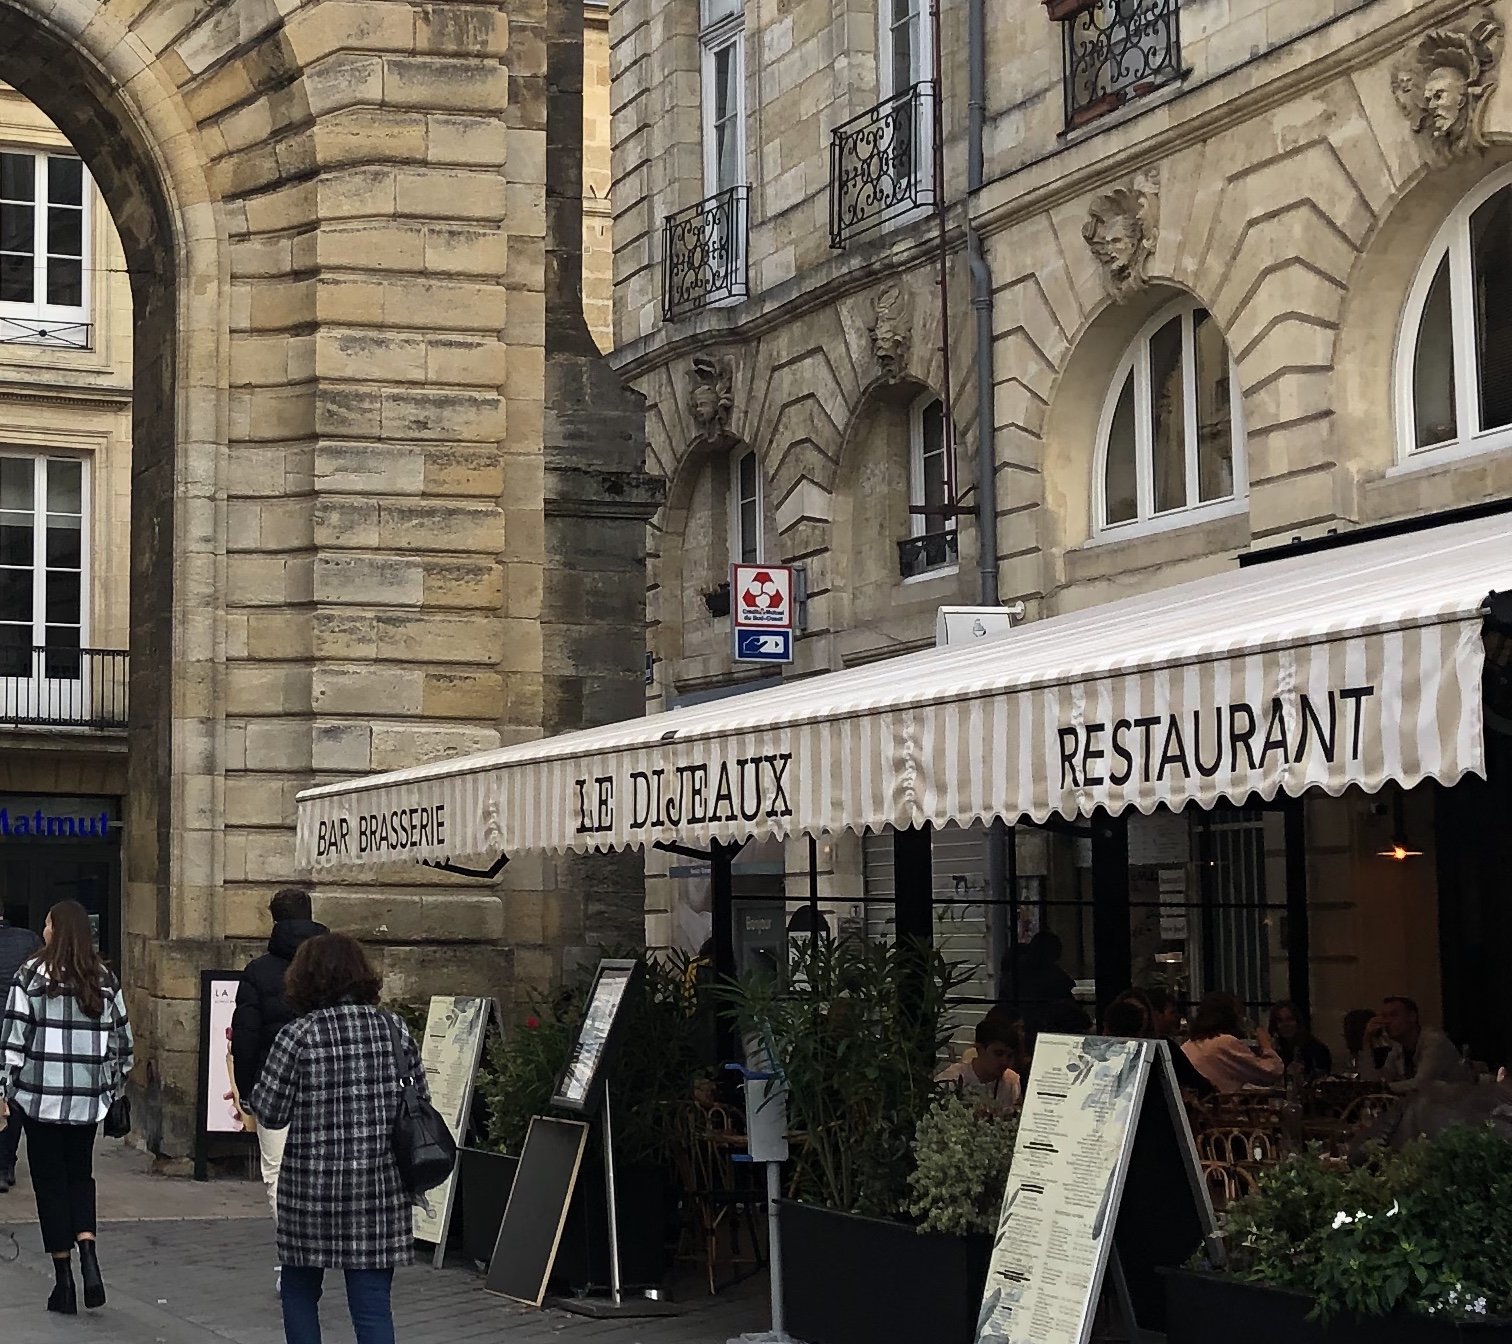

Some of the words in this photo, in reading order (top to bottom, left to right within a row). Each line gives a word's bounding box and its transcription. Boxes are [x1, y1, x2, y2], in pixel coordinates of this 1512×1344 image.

[1057, 685, 1375, 790] RESTAURANT
[316, 818, 350, 857] BAR
[358, 803, 446, 853] BRASSERIE
[575, 775, 614, 835] LE
[629, 752, 793, 831] DIJEAUX
